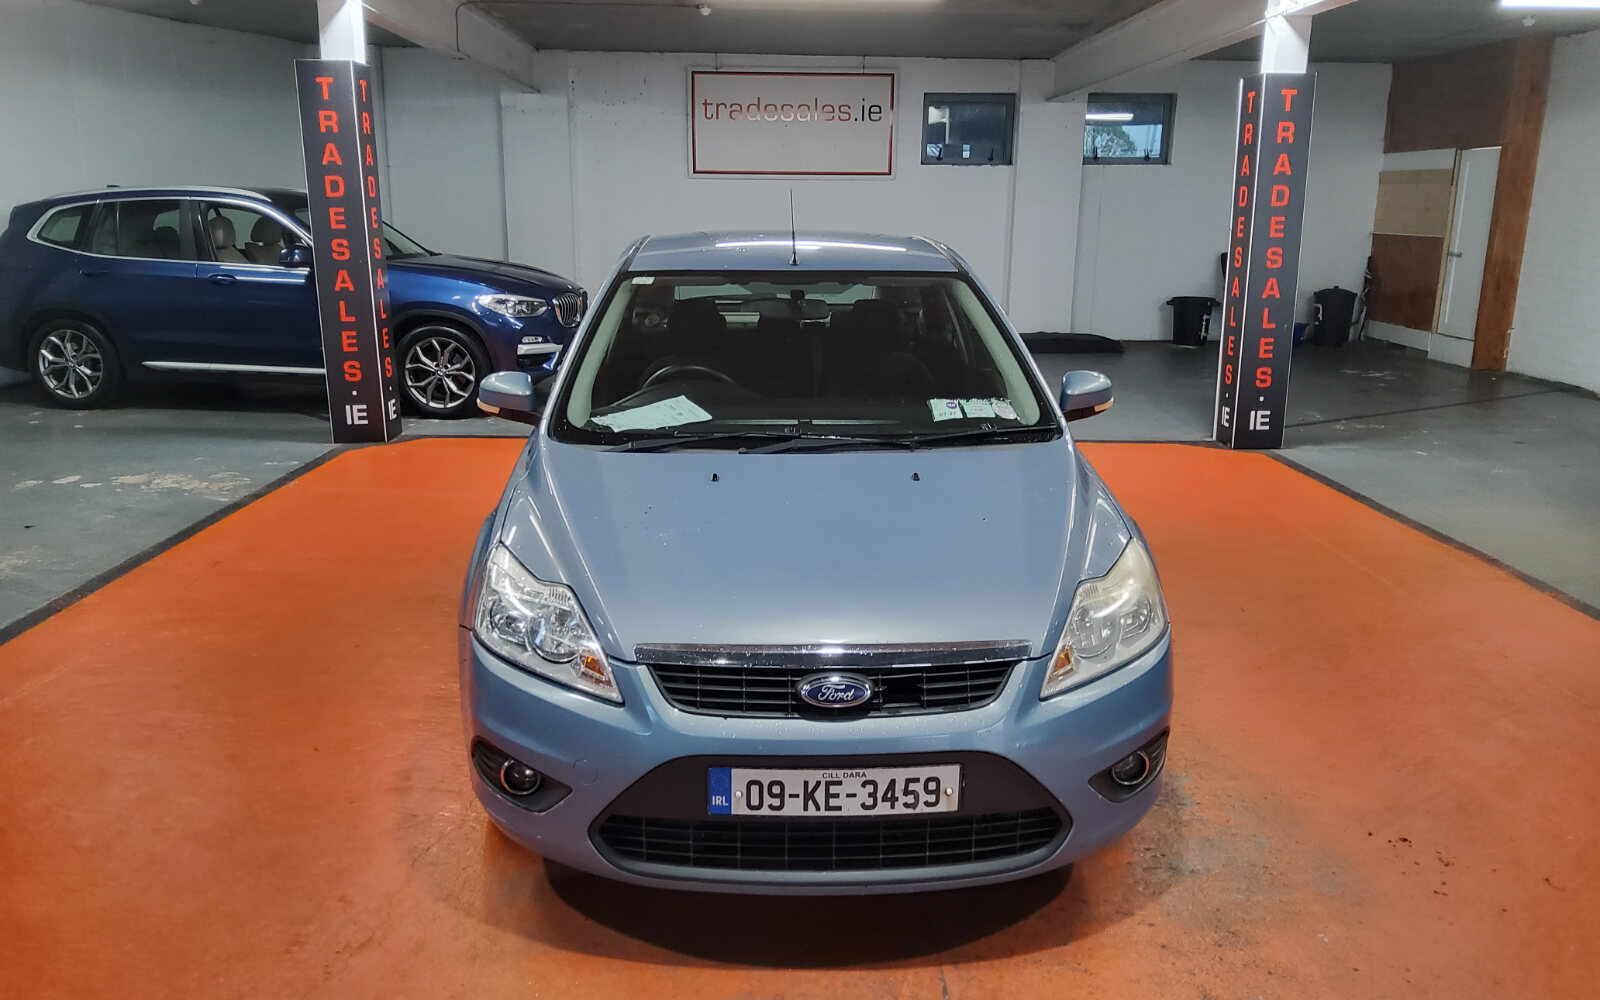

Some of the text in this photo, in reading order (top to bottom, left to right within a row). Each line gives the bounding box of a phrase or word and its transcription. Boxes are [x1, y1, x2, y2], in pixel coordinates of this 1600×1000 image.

[702, 96, 882, 122] tradesales.ie
[817, 684, 855, 701] Ford
[843, 771, 867, 779] DARA
[711, 795, 728, 806] IRL
[745, 776, 941, 812] 09-KE-3459
